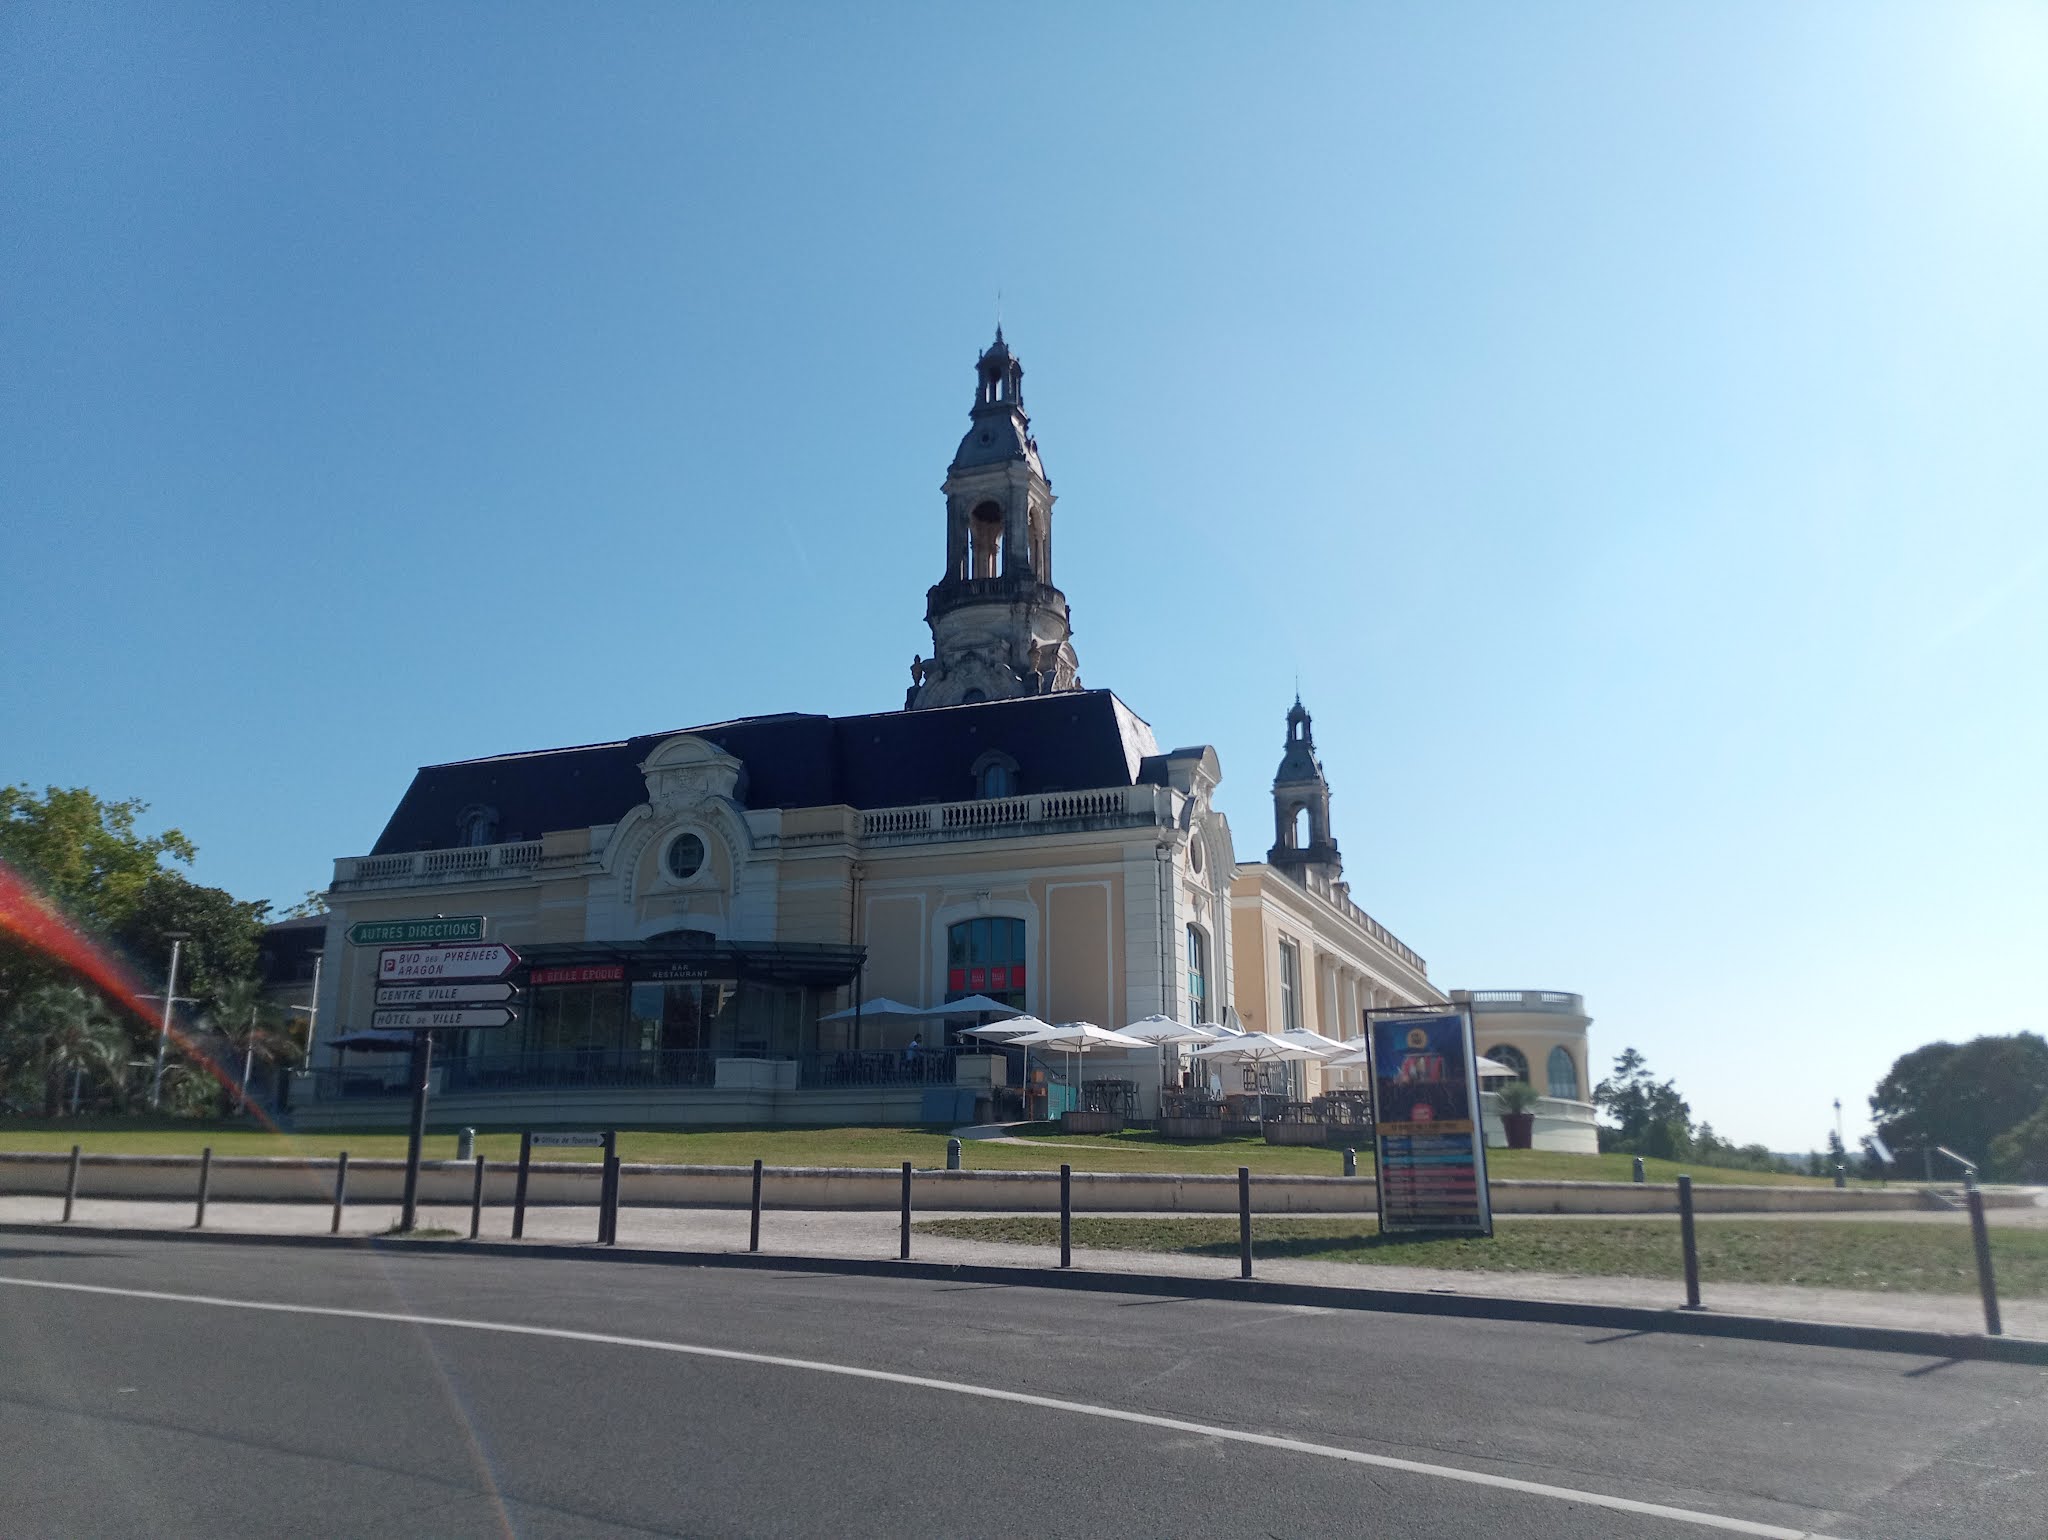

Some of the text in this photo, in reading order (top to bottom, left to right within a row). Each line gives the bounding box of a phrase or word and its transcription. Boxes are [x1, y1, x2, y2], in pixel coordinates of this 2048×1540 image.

[360, 922, 477, 940] AUTRES DIRECTIONS
[399, 953, 420, 964] BVD
[443, 949, 499, 962] PYRÉNÉES
[398, 965, 444, 976] ARAGON
[530, 972, 543, 984] LA
[547, 970, 577, 982] BELLE
[652, 970, 708, 978] RESTAURANT
[380, 988, 458, 1001] CENTRE VILLE
[376, 1012, 411, 1025] HÔTEL
[432, 1013, 462, 1024] VILLE
[542, 1136, 560, 1144] Office
[561, 1136, 569, 1144] de
